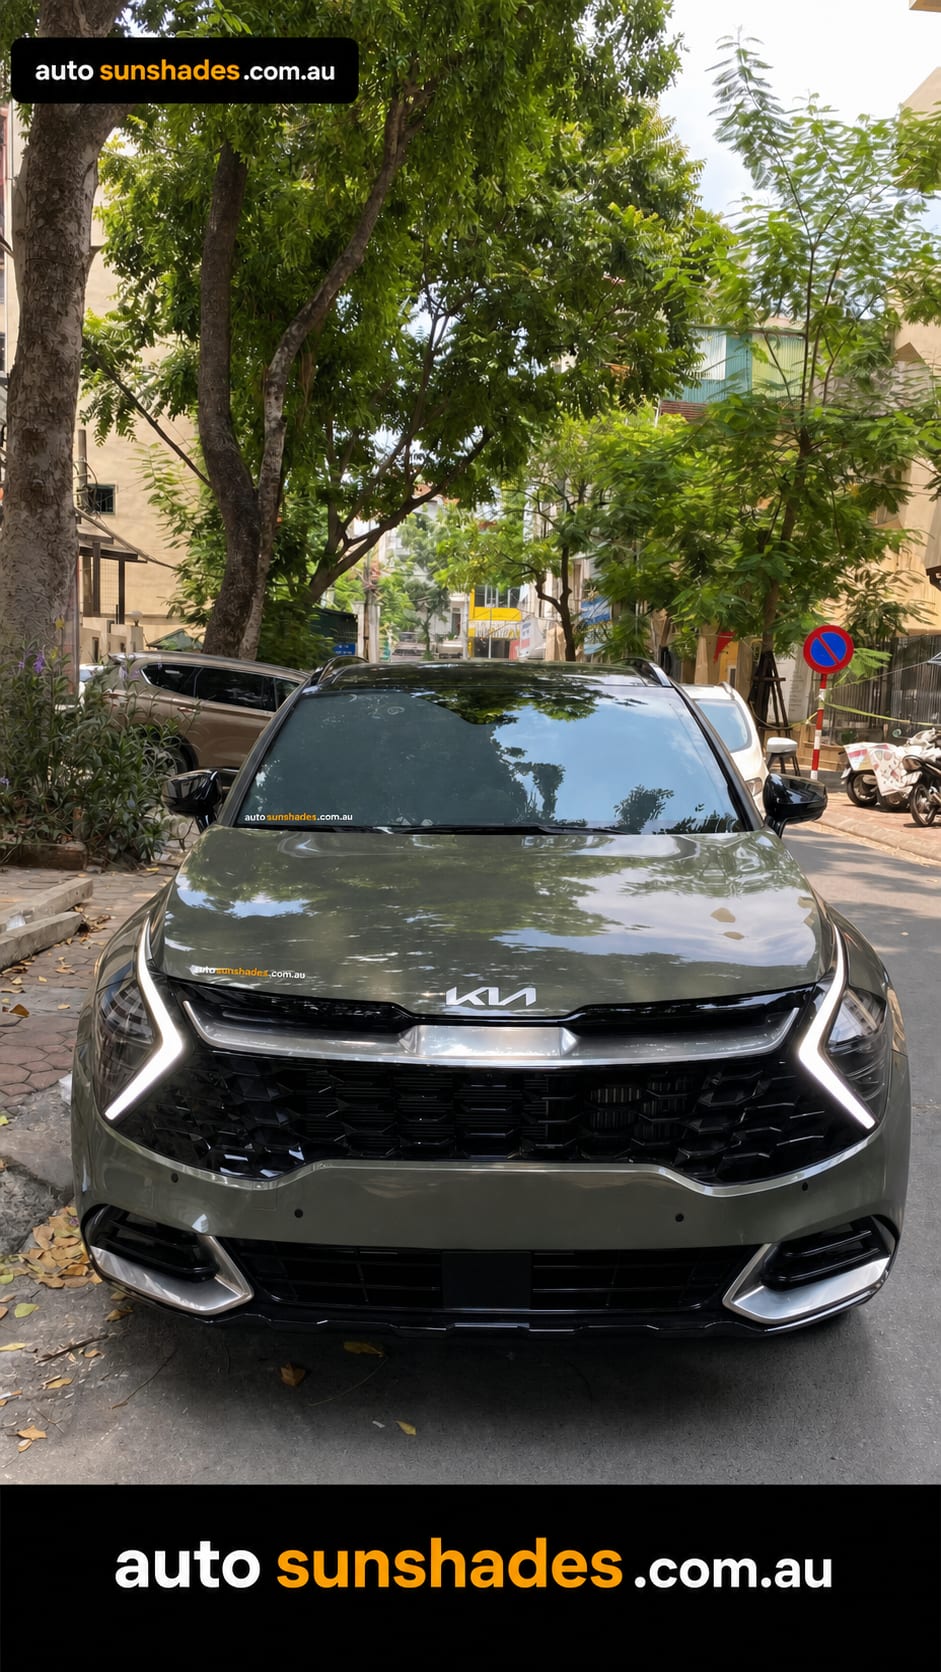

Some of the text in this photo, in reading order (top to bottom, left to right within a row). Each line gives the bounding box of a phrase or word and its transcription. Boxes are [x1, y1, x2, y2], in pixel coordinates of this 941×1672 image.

[244, 813, 266, 822] auto
[266, 812, 317, 822] sunshades
[445, 985, 537, 1007] KIA
